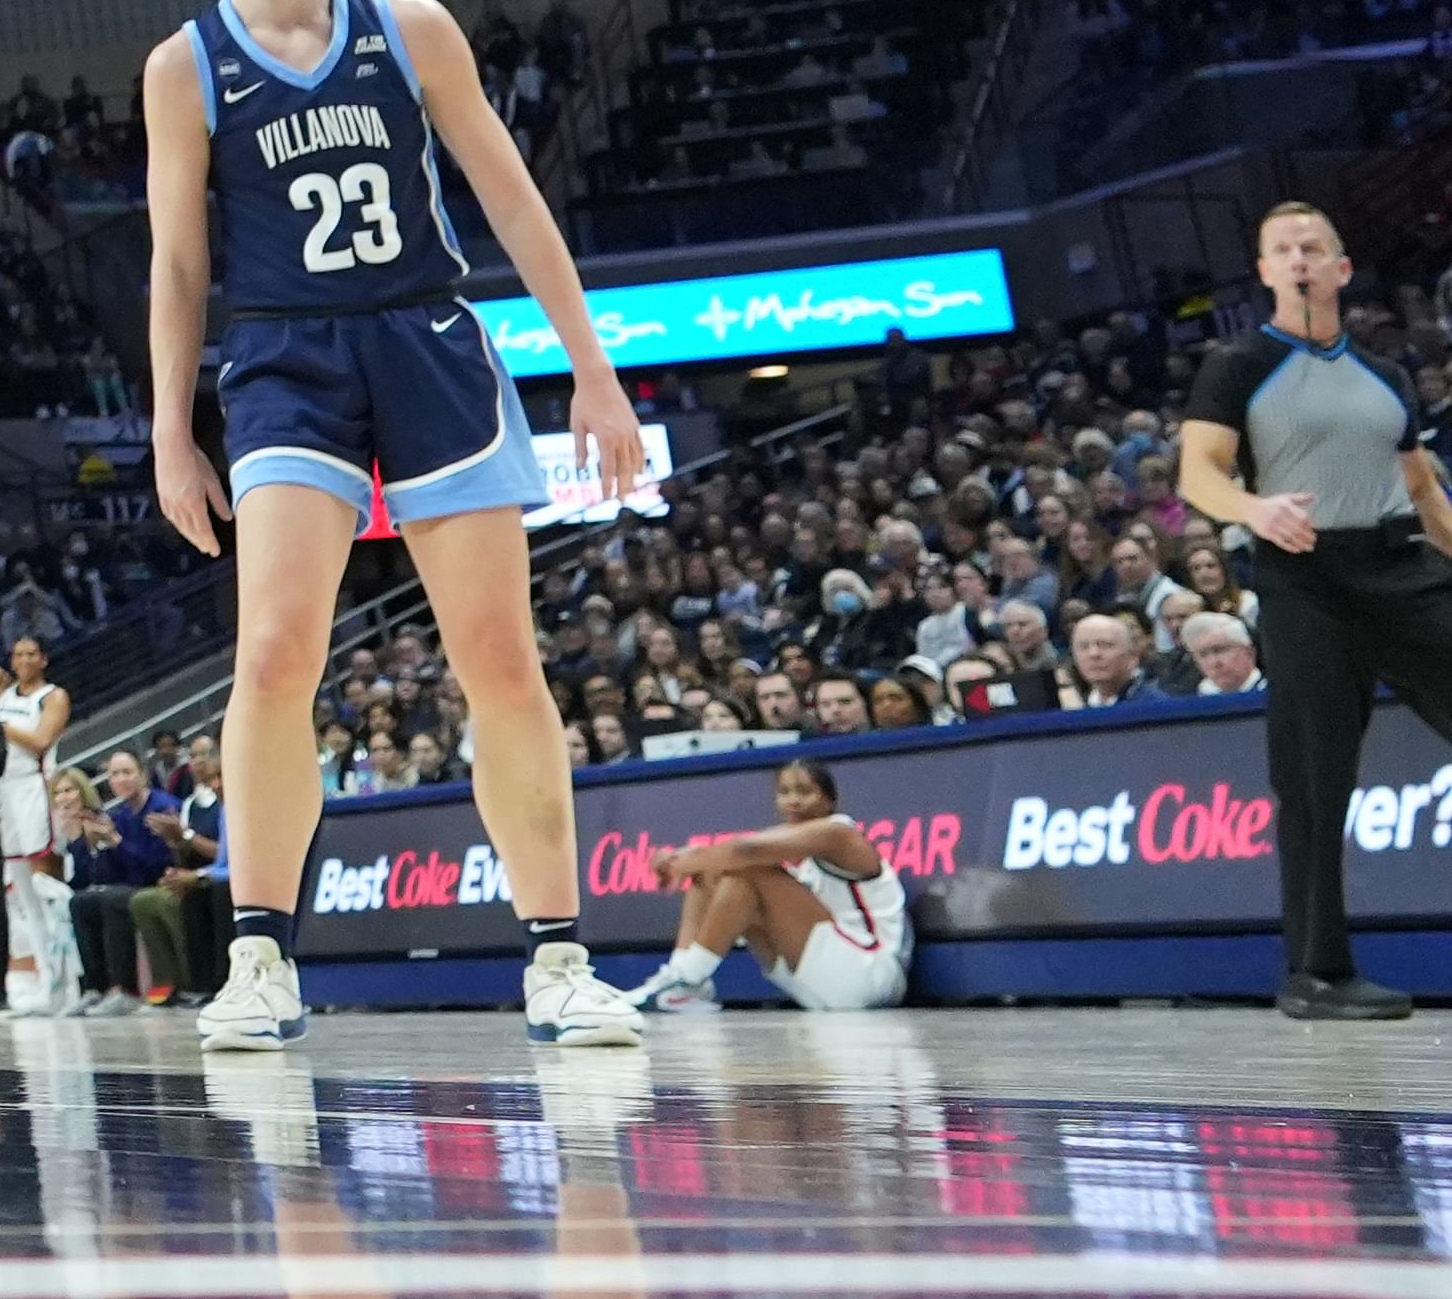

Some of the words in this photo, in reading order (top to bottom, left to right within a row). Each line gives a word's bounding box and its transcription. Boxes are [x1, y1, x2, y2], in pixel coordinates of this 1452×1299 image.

[256, 104, 392, 170] VILLANOVA
[288, 161, 403, 273] 23
[1003, 791, 1136, 870] Best
[314, 855, 390, 914] Best
[387, 851, 460, 909] Coke
